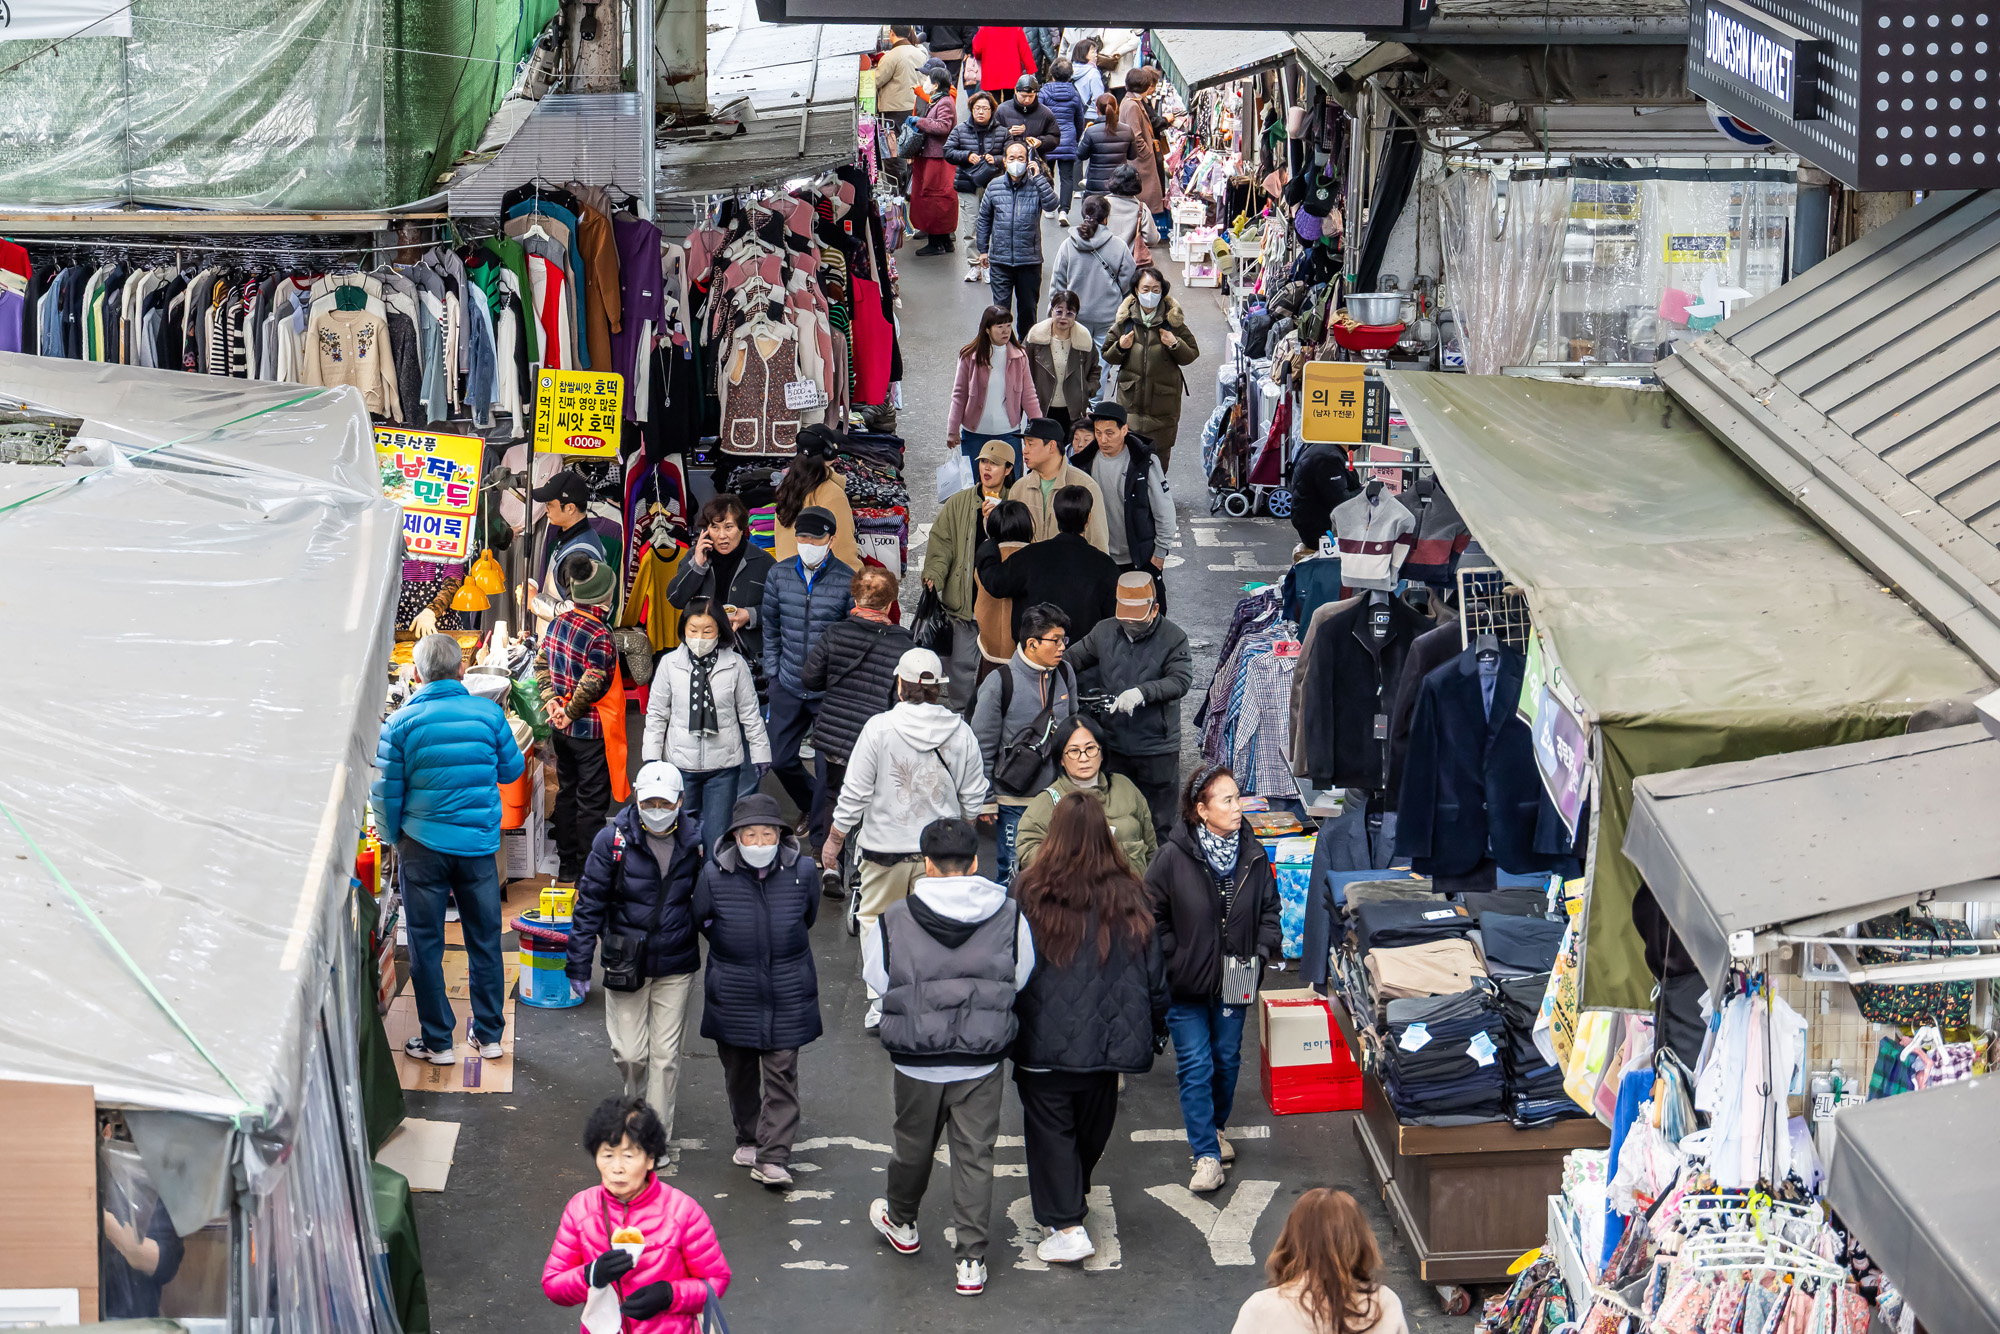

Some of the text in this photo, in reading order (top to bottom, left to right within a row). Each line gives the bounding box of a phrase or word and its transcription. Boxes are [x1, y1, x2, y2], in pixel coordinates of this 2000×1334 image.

[1706, 8, 1793, 103] DONGSAN MARKET
[559, 379, 618, 397] 찹쌀씨앗 호떡
[558, 396, 617, 412] 진짜 영양 많은
[1312, 409, 1356, 419] (남자 T전문)
[538, 396, 551, 435] 먹거리
[557, 412, 615, 434] 씨앗 호떡
[395, 453, 458, 482] 납작
[413, 479, 470, 507] 만두
[874, 537, 895, 546] 5000
